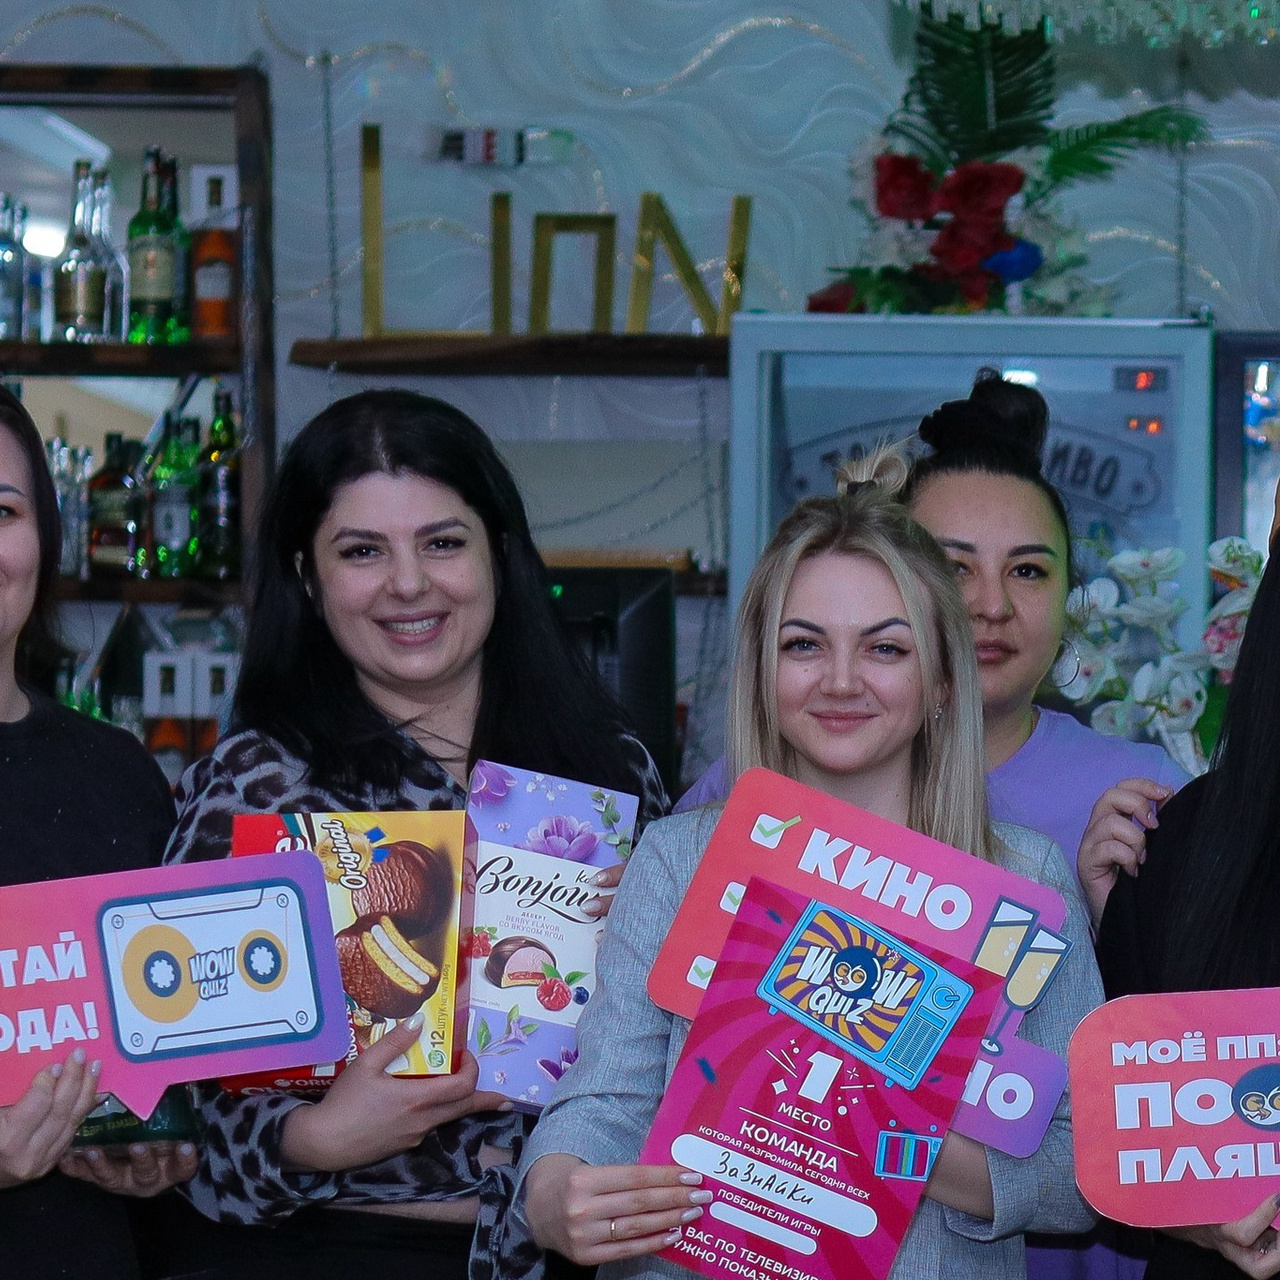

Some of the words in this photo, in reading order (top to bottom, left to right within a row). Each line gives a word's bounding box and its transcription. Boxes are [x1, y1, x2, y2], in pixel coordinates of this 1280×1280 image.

[1047, 440, 1123, 498] ИВО
[321, 819, 368, 890] Original
[477, 856, 600, 924] Bonjou
[798, 828, 972, 931] КИНО
[499, 920, 510, 928] СО
[544, 930, 565, 942] ЯГОД
[505, 914, 530, 926] BERRY
[188, 946, 236, 984] WOW
[198, 977, 229, 1000] QUIZ
[808, 985, 874, 1025] QUIZ
[430, 1030, 445, 1049] 12
[1112, 1031, 1207, 1066] МОЁ
[798, 1050, 842, 1104] 1
[777, 1101, 833, 1132] МЕСТО
[698, 1125, 743, 1149] КОТОРАЯ
[742, 1142, 804, 1173] РАЗГРОМИЛА
[804, 1167, 848, 1191] СЕГОДНЯ
[846, 1184, 871, 1201] ВСЕХ
[739, 1120, 838, 1173] КОМАНДА
[717, 1188, 790, 1224] ПОБЕДИТЕЛИ
[790, 1217, 822, 1237] ИГРЫ
[673, 1239, 717, 1264] УЖНО
[685, 1226, 714, 1246] ВАС
[715, 1238, 737, 1254] ПО
